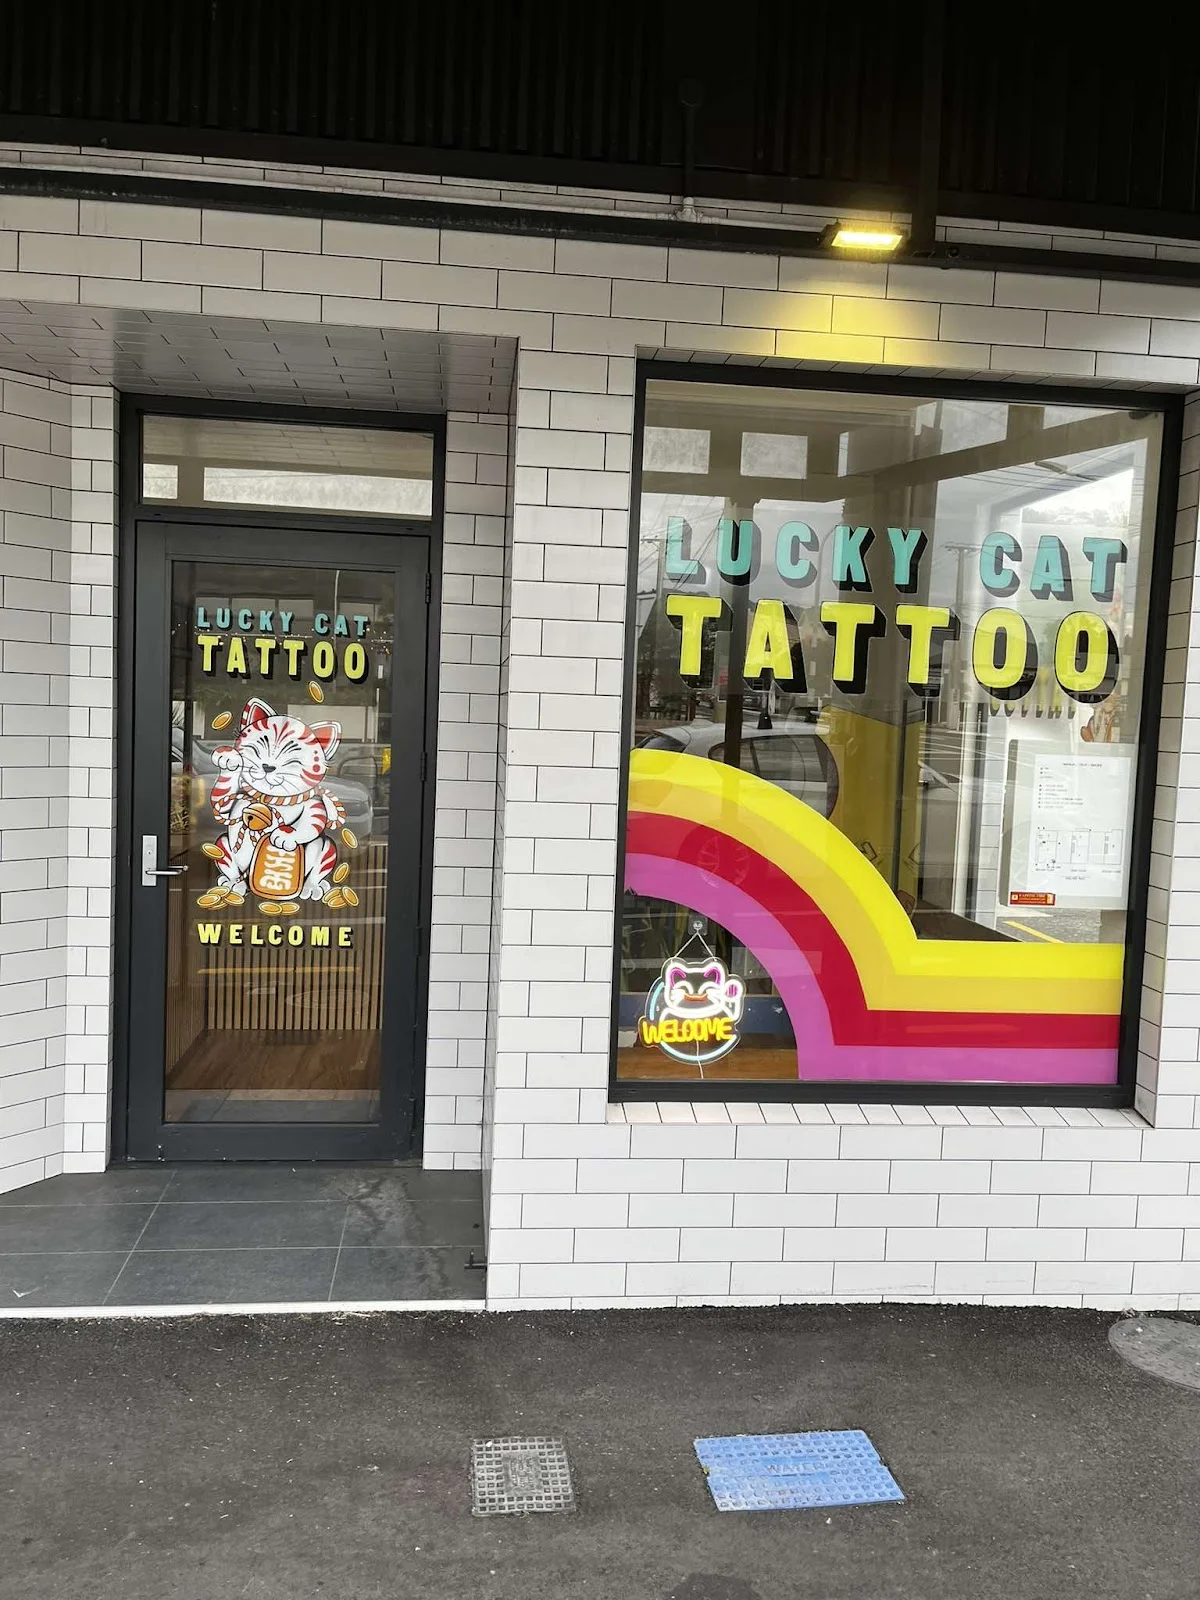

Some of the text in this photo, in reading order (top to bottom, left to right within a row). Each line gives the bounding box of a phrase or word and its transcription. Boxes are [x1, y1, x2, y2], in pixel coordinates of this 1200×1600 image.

[666, 517, 1127, 600] LUCKY CAT
[197, 607, 370, 637] LUCKY CAT
[198, 635, 369, 683] TATTOO
[666, 594, 1119, 702] TATTOO
[197, 923, 353, 948] WELCOME
[642, 1018, 734, 1044] WELCOME
